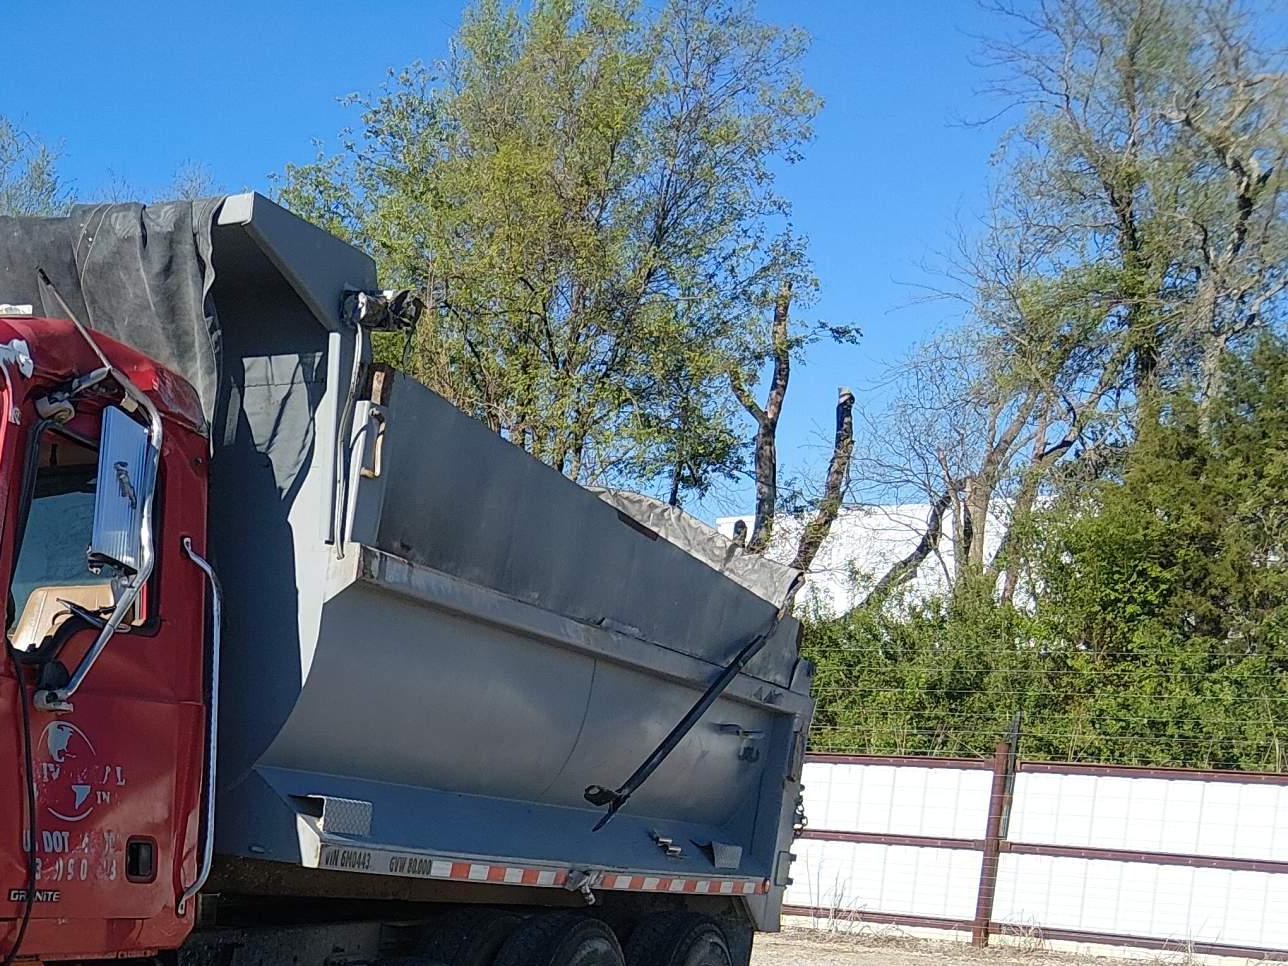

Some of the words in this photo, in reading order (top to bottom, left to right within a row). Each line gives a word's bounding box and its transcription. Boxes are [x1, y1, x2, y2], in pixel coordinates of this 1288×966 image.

[42, 830, 70, 853] DOT
[389, 855, 408, 873] GVW
[10, 889, 62, 902] GRNITE
